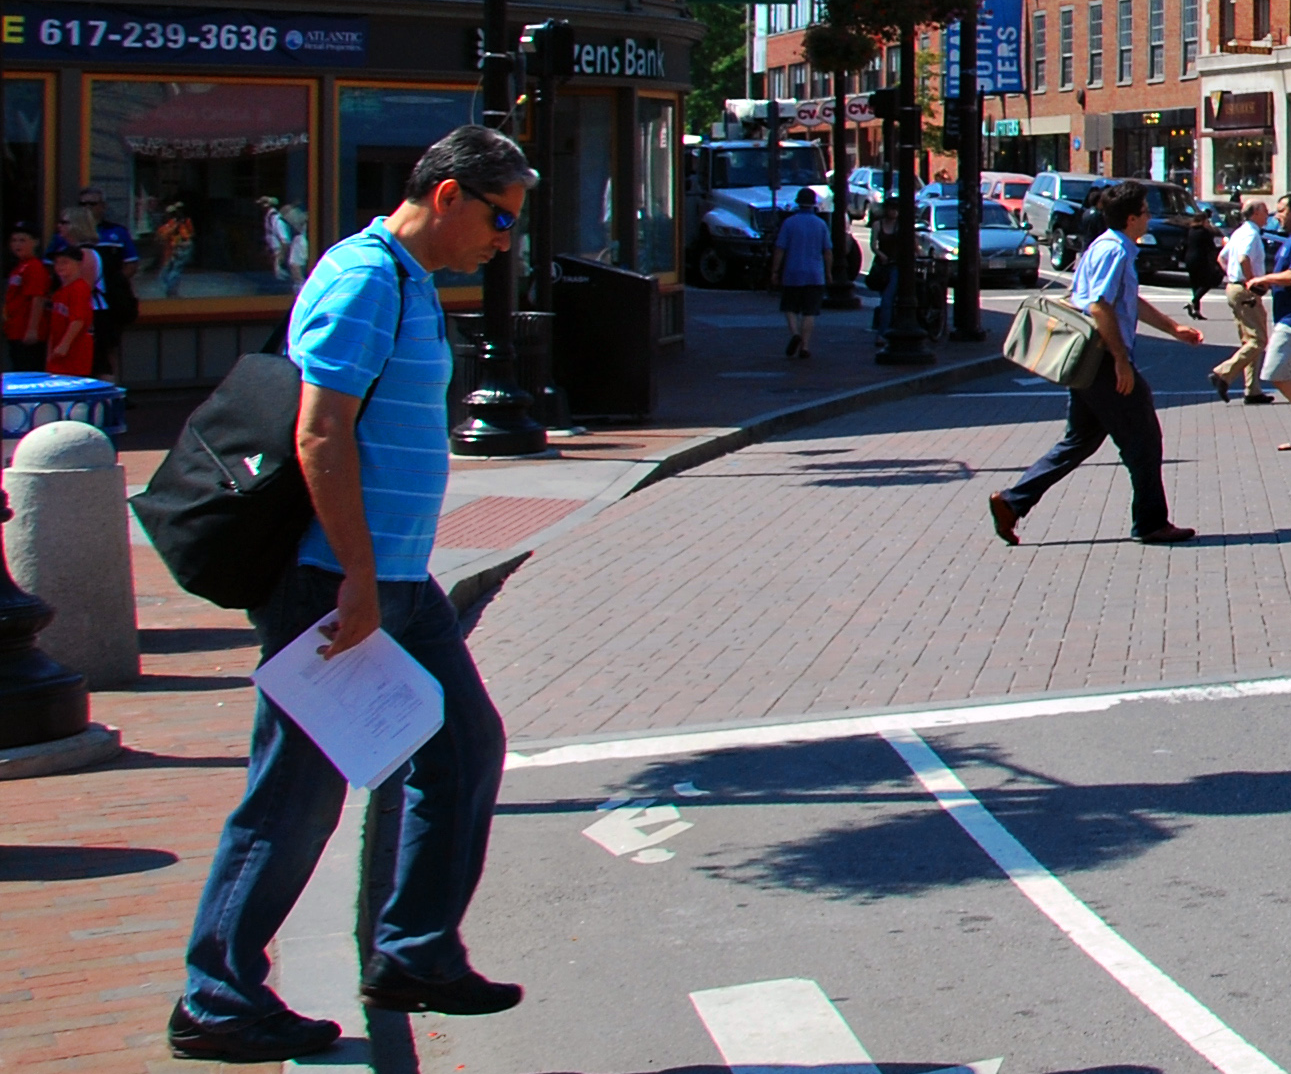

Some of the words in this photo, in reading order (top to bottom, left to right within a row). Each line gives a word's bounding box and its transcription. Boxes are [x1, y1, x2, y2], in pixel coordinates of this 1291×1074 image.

[39, 19, 277, 51] 617-239-3636
[305, 30, 363, 42] ATLANTIC
[574, 43, 620, 75] zens
[624, 38, 666, 77] Bank
[997, 26, 1018, 89] TERS
